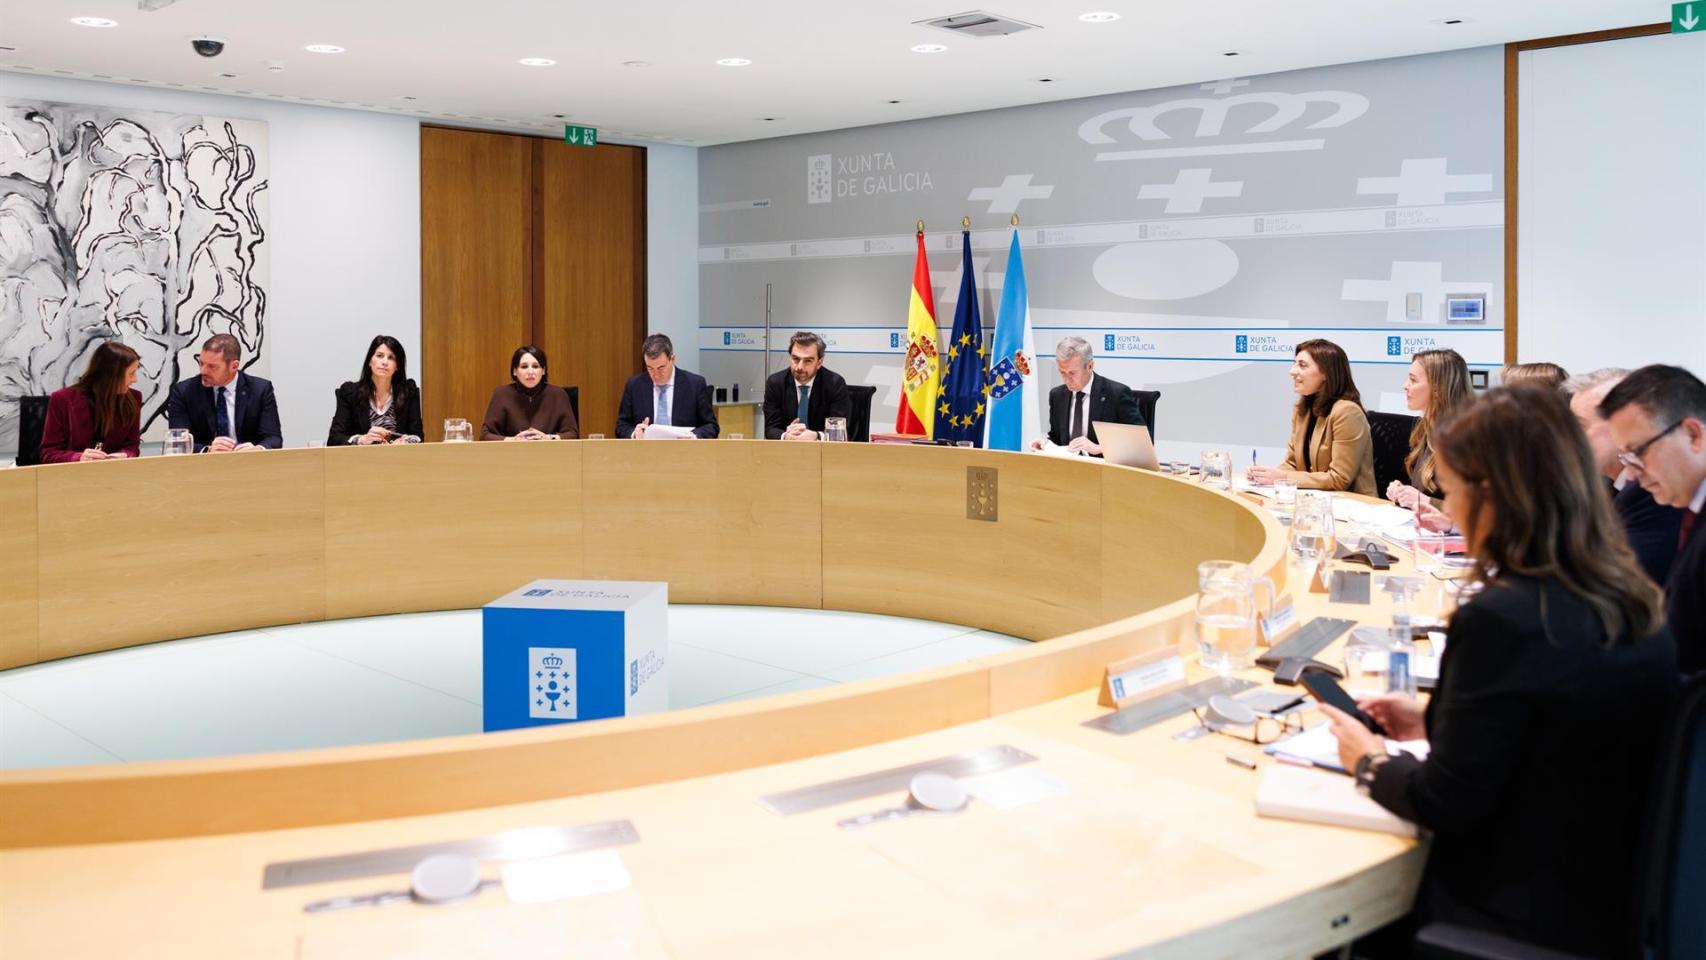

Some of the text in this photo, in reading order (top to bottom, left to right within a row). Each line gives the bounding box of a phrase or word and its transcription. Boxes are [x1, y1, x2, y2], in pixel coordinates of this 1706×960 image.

[838, 152, 896, 175] XUNTA
[837, 171, 934, 197] DE GALICIA
[1117, 335, 1141, 343] XUNTA
[1250, 336, 1277, 344] XUNTA
[1404, 337, 1436, 346] XUNTA
[1127, 343, 1156, 351] GALICIA
[1403, 346, 1415, 355] DE
